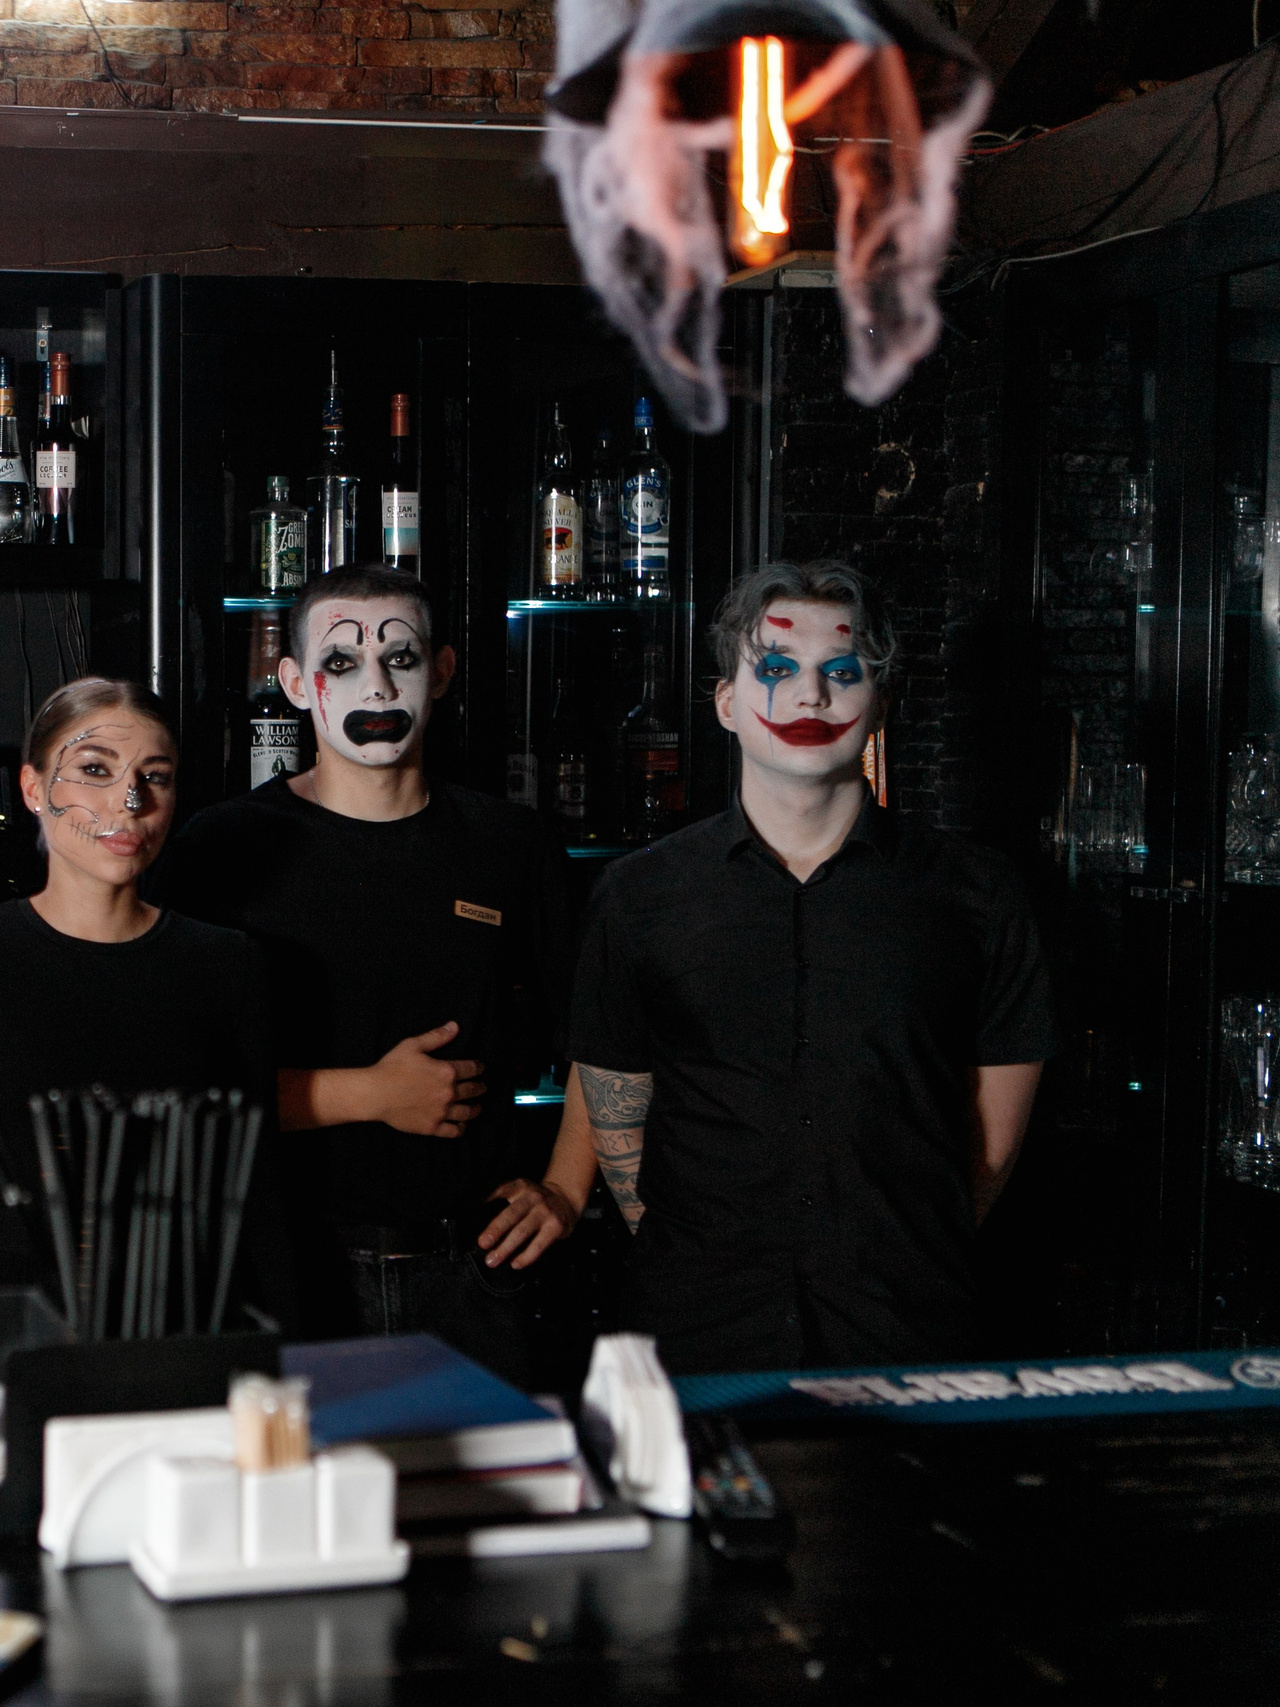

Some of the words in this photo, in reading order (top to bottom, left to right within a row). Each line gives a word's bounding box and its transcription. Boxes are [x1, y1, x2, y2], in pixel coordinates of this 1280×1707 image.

[626, 478, 662, 489] GLEN'S
[255, 725, 298, 736] WILLIAM
[253, 750, 271, 758] BLENDD
[460, 904, 496, 920] Богдан
